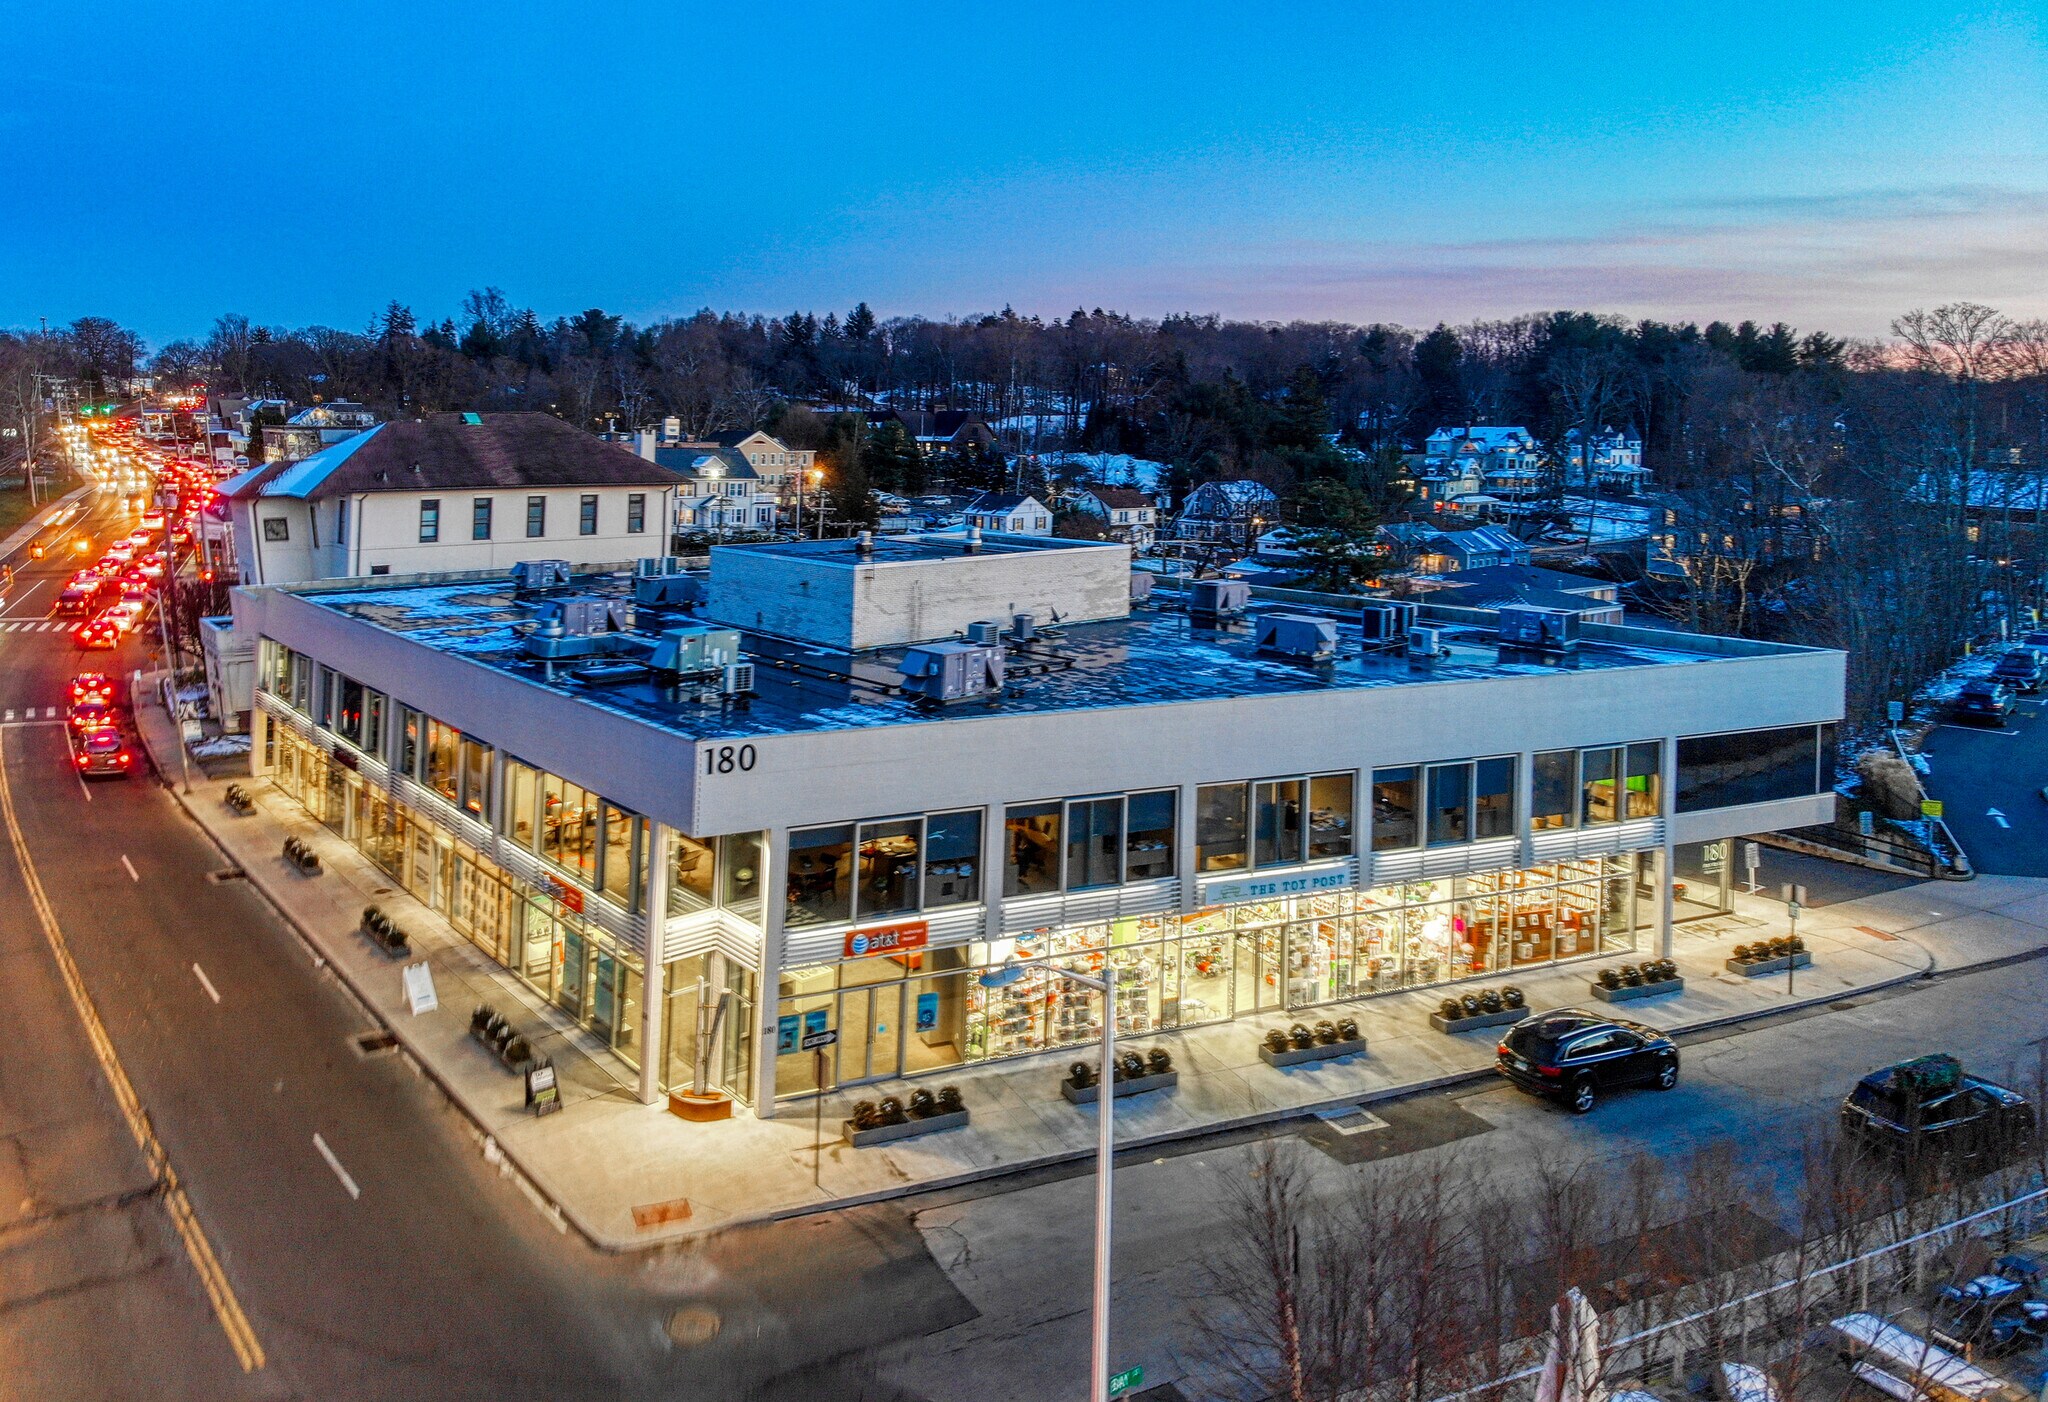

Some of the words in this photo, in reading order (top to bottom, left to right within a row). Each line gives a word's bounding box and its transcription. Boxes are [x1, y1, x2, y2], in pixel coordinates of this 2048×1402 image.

[704, 744, 757, 775] 180
[1703, 842, 1728, 861] 180
[1250, 883, 1276, 896] THE
[1282, 879, 1306, 892] TOY
[1312, 874, 1345, 888] POST
[869, 929, 900, 949] at&t
